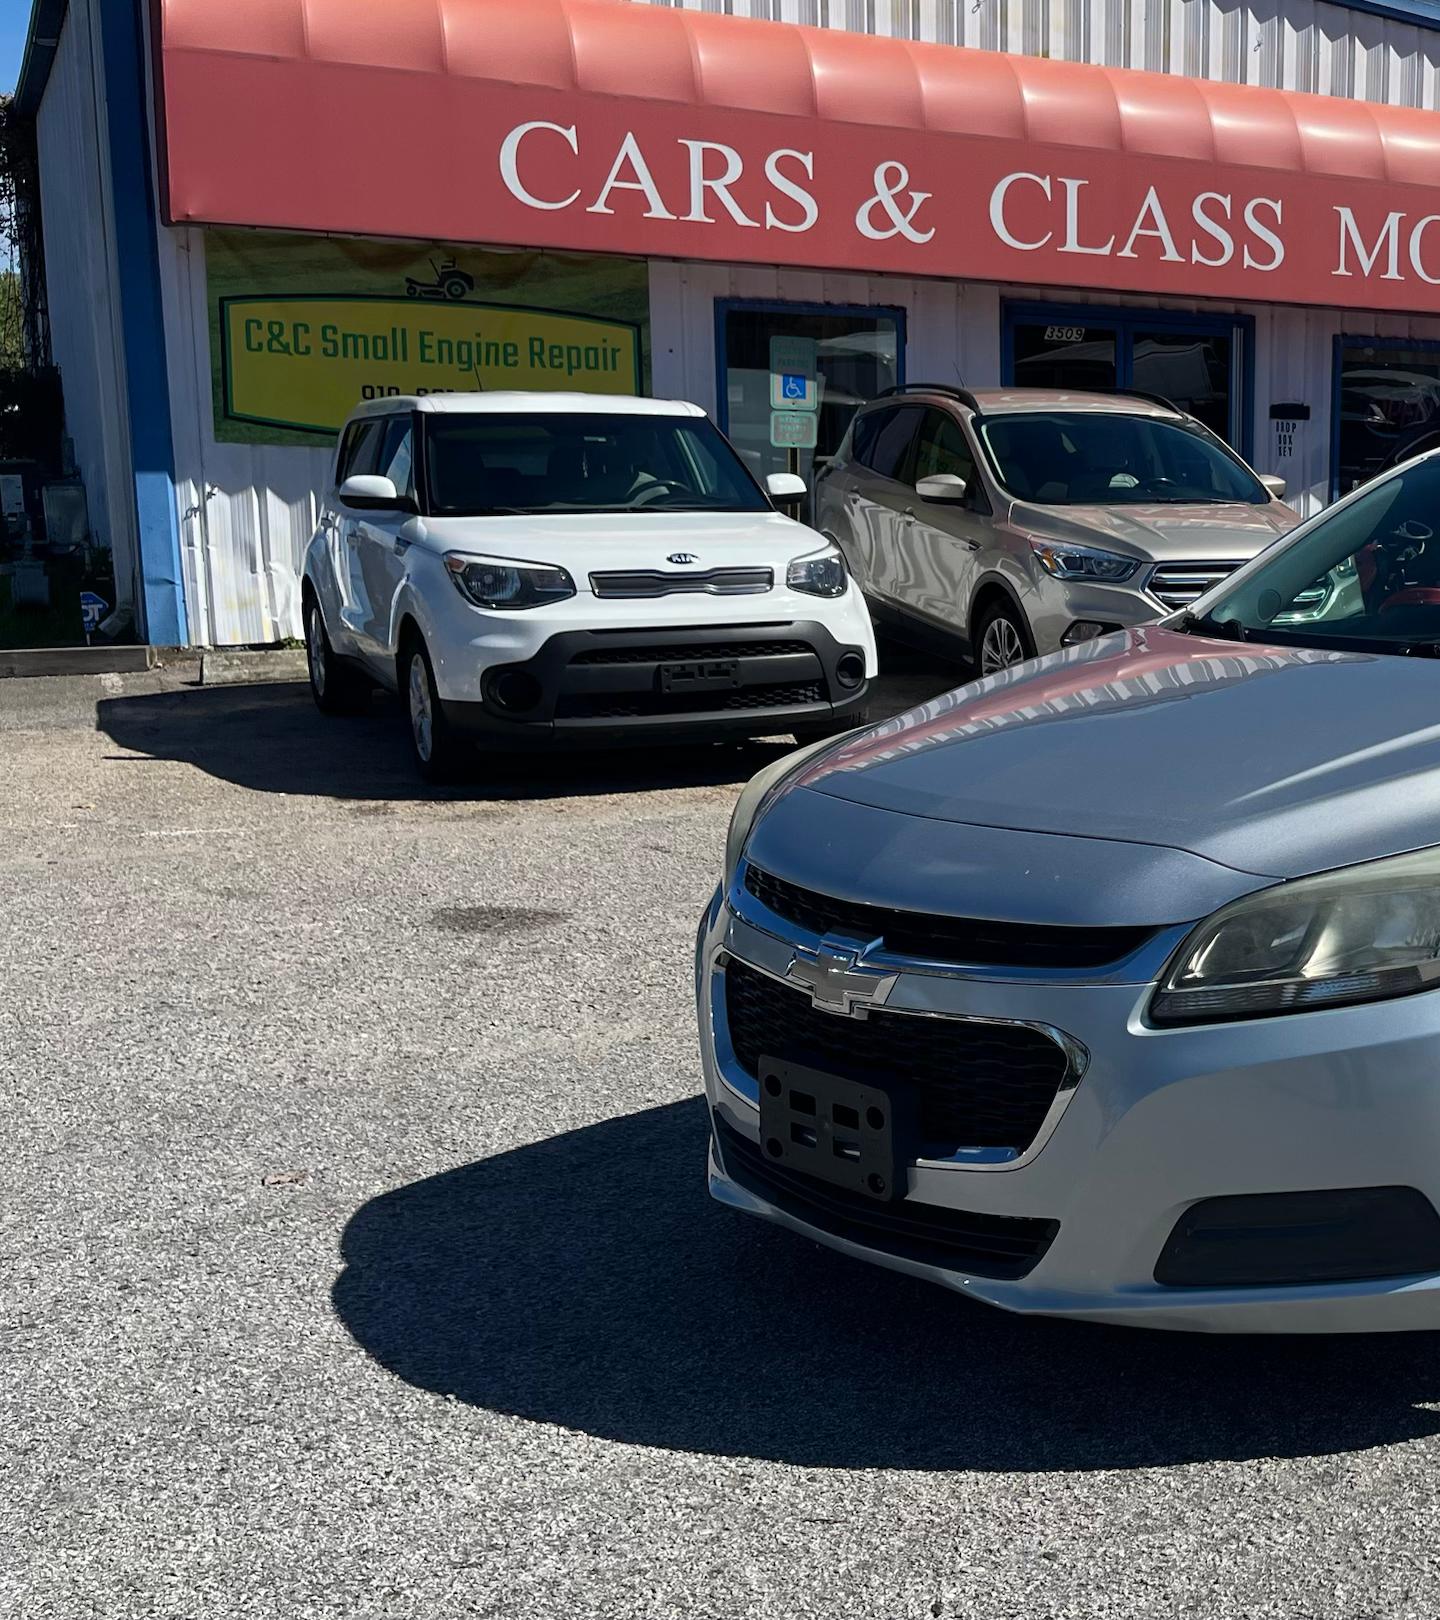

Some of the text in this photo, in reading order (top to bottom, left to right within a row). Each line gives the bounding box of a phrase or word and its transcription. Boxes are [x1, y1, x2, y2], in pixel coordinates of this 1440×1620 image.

[498, 120, 820, 233] CARS
[854, 160, 936, 244] &
[988, 172, 1286, 271] CLASS
[244, 319, 622, 377] C&C Small Engine Repair
[1046, 327, 1083, 340] 3509
